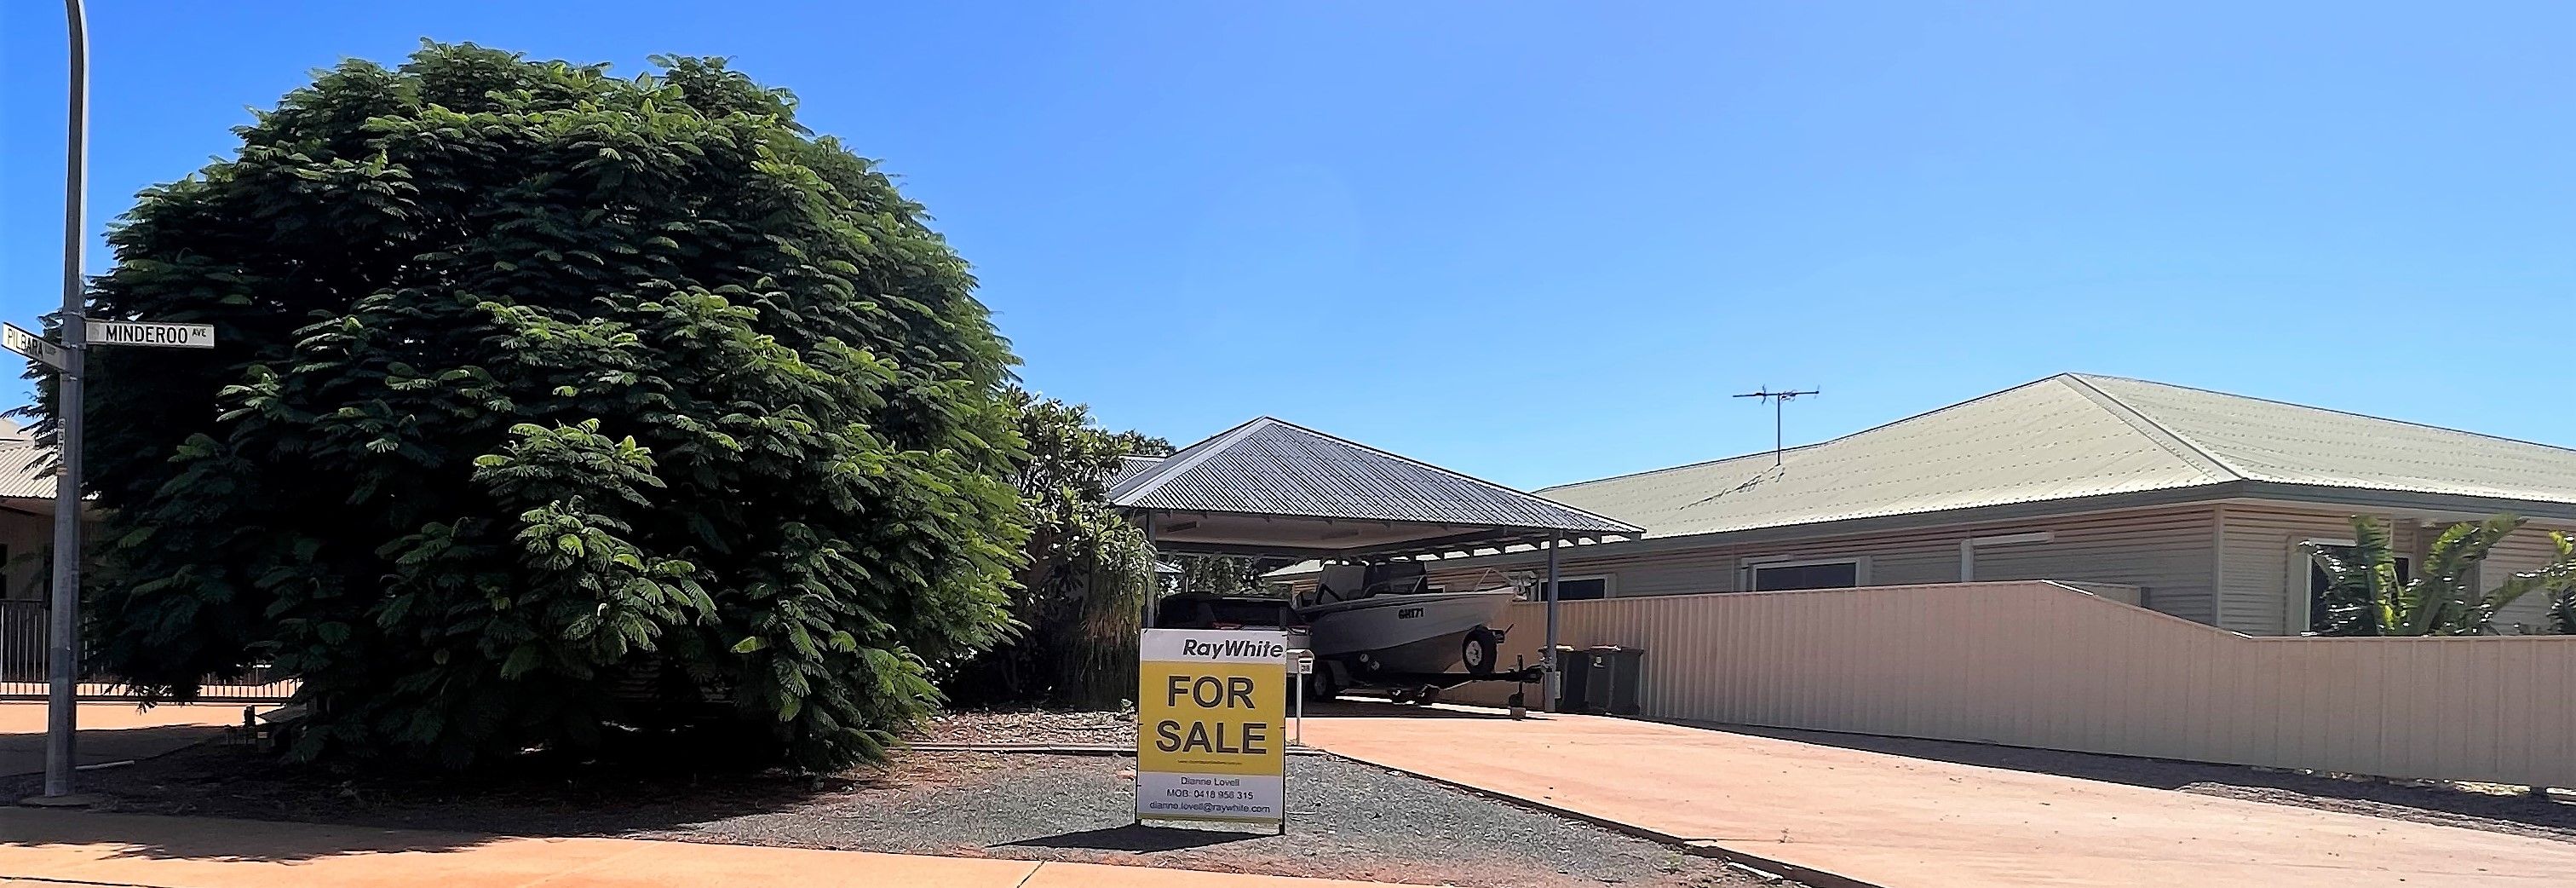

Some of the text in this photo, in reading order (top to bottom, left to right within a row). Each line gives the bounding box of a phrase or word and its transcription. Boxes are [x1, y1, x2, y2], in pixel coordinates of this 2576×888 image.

[7, 327, 43, 359] PILBARA
[106, 325, 207, 343] MINDEROO AVE
[1168, 675, 1256, 709] FOR
[1155, 719, 1268, 754] SALE
[1181, 776, 1240, 787] Dianne Lovell
[1193, 789, 1216, 799] 0418
[1237, 791, 1254, 799] 315
